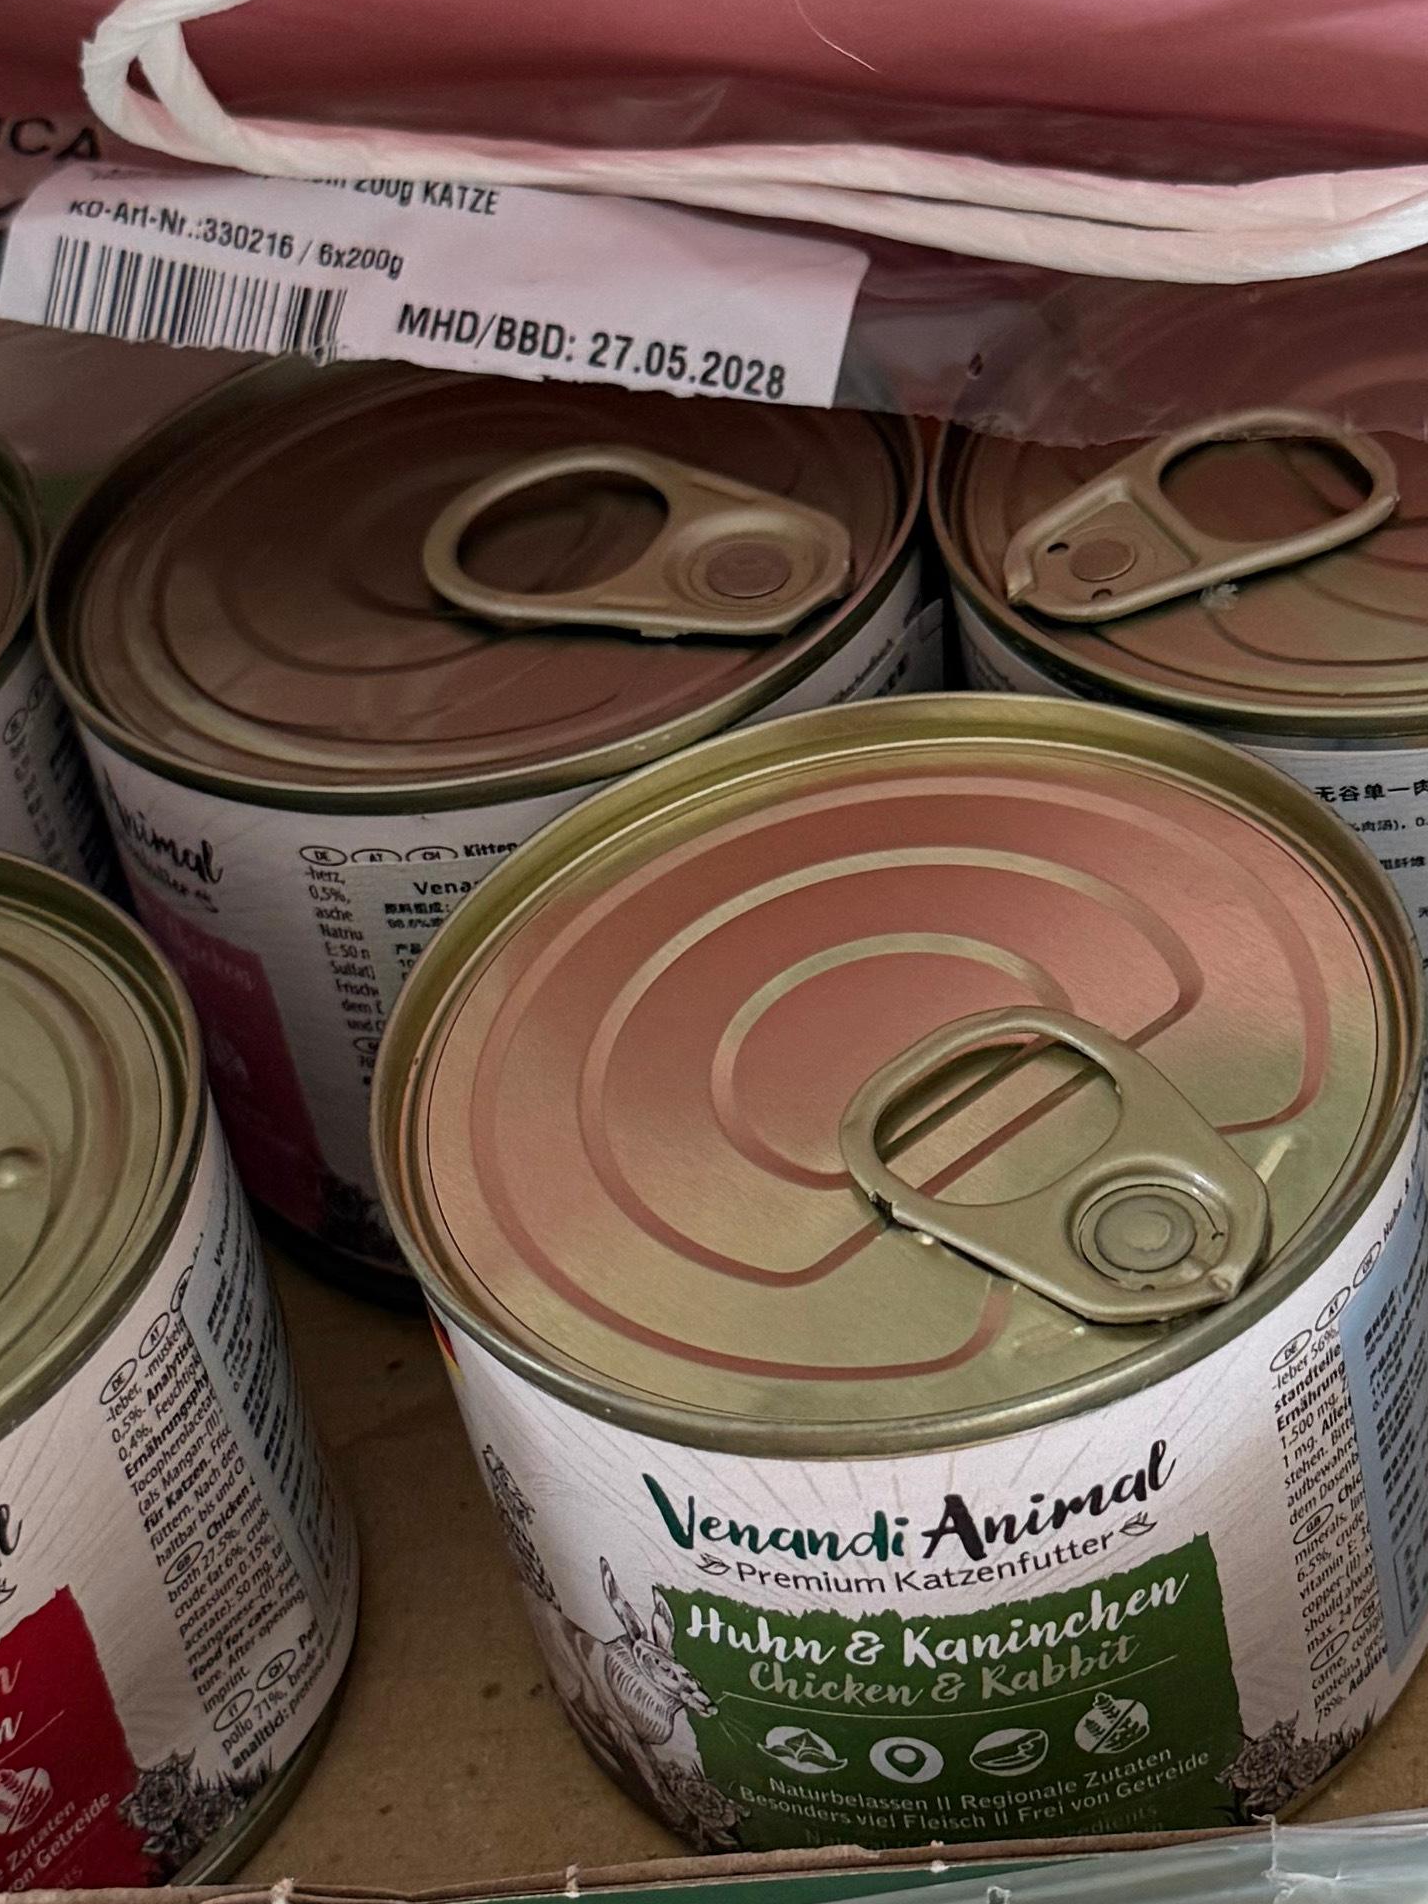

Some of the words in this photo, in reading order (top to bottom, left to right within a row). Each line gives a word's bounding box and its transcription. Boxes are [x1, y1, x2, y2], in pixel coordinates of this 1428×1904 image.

[422, 181, 500, 217] KATZE
[318, 243, 405, 281] 6x200g
[397, 304, 577, 363] MHD/BBD:
[587, 331, 787, 399] 27.05.2028
[124, 1369, 210, 1481] Ernährungsphy
[1276, 1360, 1347, 1433] Ernährung
[642, 1473, 910, 1562] Venandi
[921, 1438, 1177, 1562] Animal
[155, 1518, 199, 1568] haltbar
[737, 1561, 886, 1595] Premium
[896, 1530, 1116, 1593] Katzenfutter
[168, 1565, 202, 1604] broth
[190, 1648, 224, 1683] food
[224, 1626, 245, 1652] for
[686, 1604, 839, 1666] Huhn
[845, 1630, 886, 1665] &
[901, 1573, 1191, 1670] Kaninchen
[749, 1662, 925, 1707] Chicken
[931, 1669, 967, 1703] &
[981, 1634, 1141, 1700] Rabbit
[739, 1785, 853, 1825] Besonders
[857, 1811, 897, 1830] viel
[903, 1811, 988, 1832] Fleisch
[1018, 1801, 1066, 1823] Frei
[1072, 1790, 1111, 1813] von
[1115, 1749, 1211, 1801] Getreide
[768, 1776, 941, 1812] Naturbelassen
[961, 1778, 1078, 1810] Regionale
[1084, 1748, 1173, 1790] Zutaten
